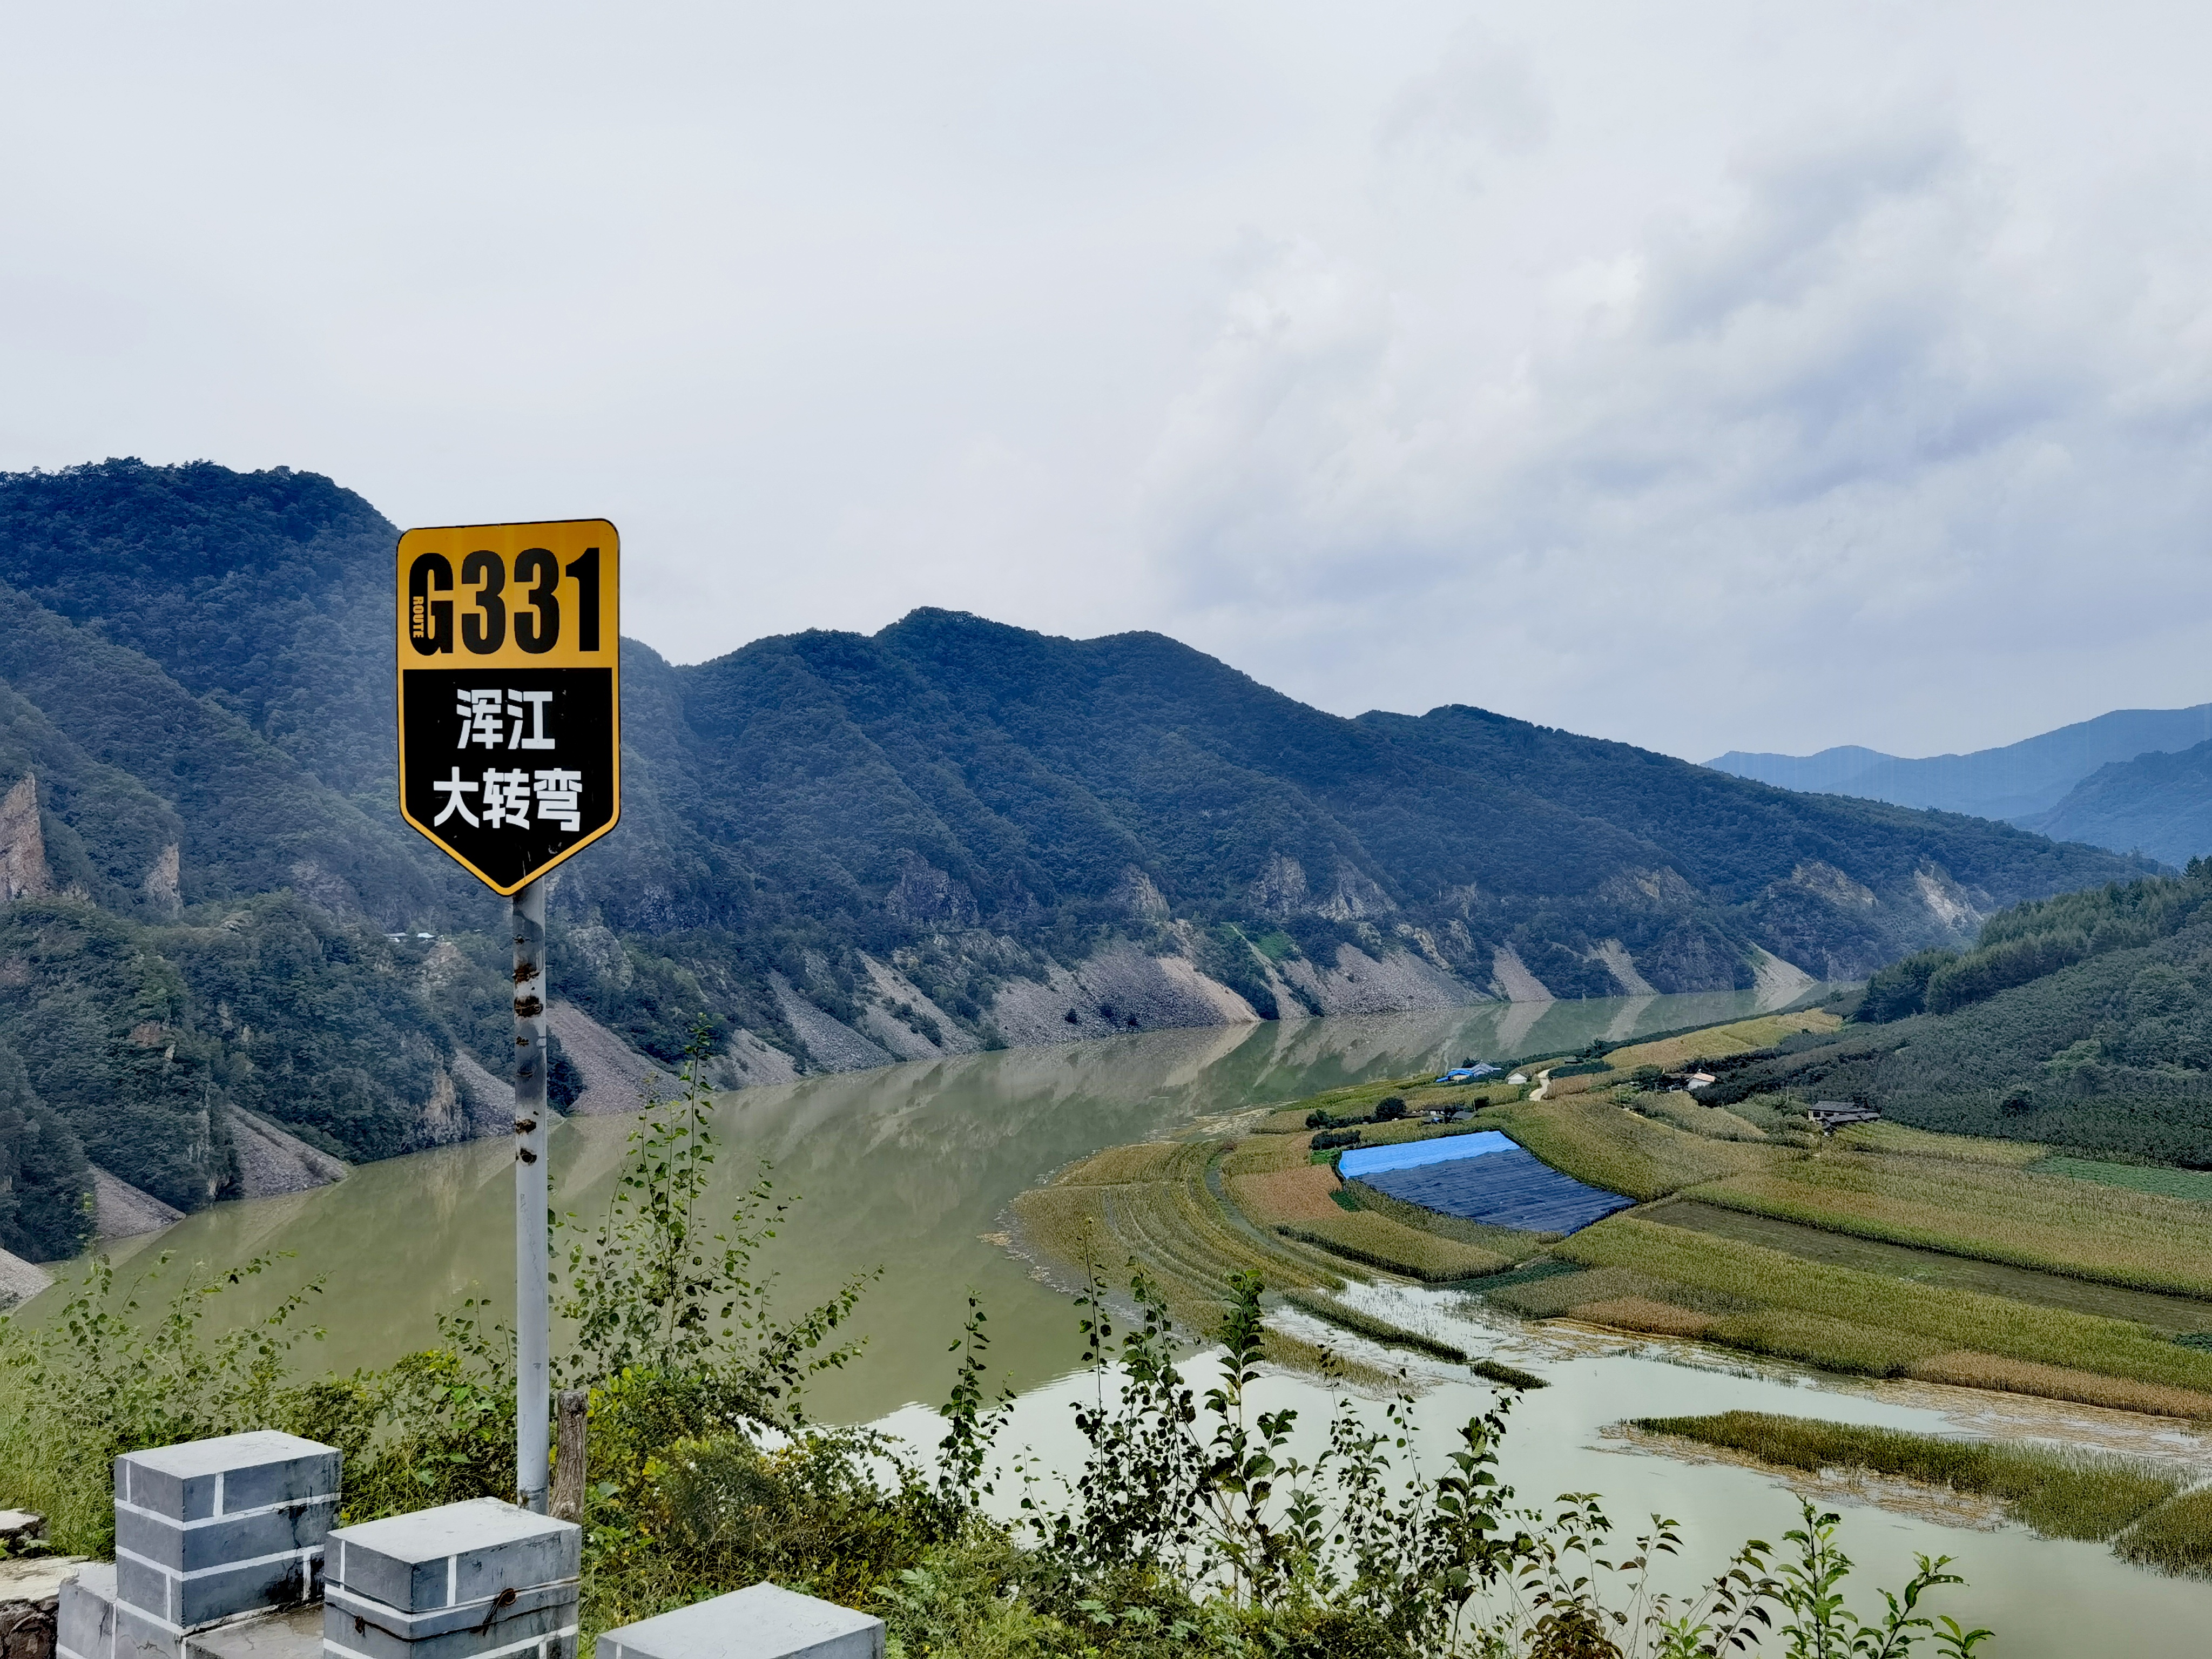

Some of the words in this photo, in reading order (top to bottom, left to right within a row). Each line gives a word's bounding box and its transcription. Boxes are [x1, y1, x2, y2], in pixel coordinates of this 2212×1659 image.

[409, 547, 599, 656] G331
[413, 596, 424, 638] ROUTE
[456, 689, 555, 750] 浑江
[433, 766, 582, 832] 大转弯
